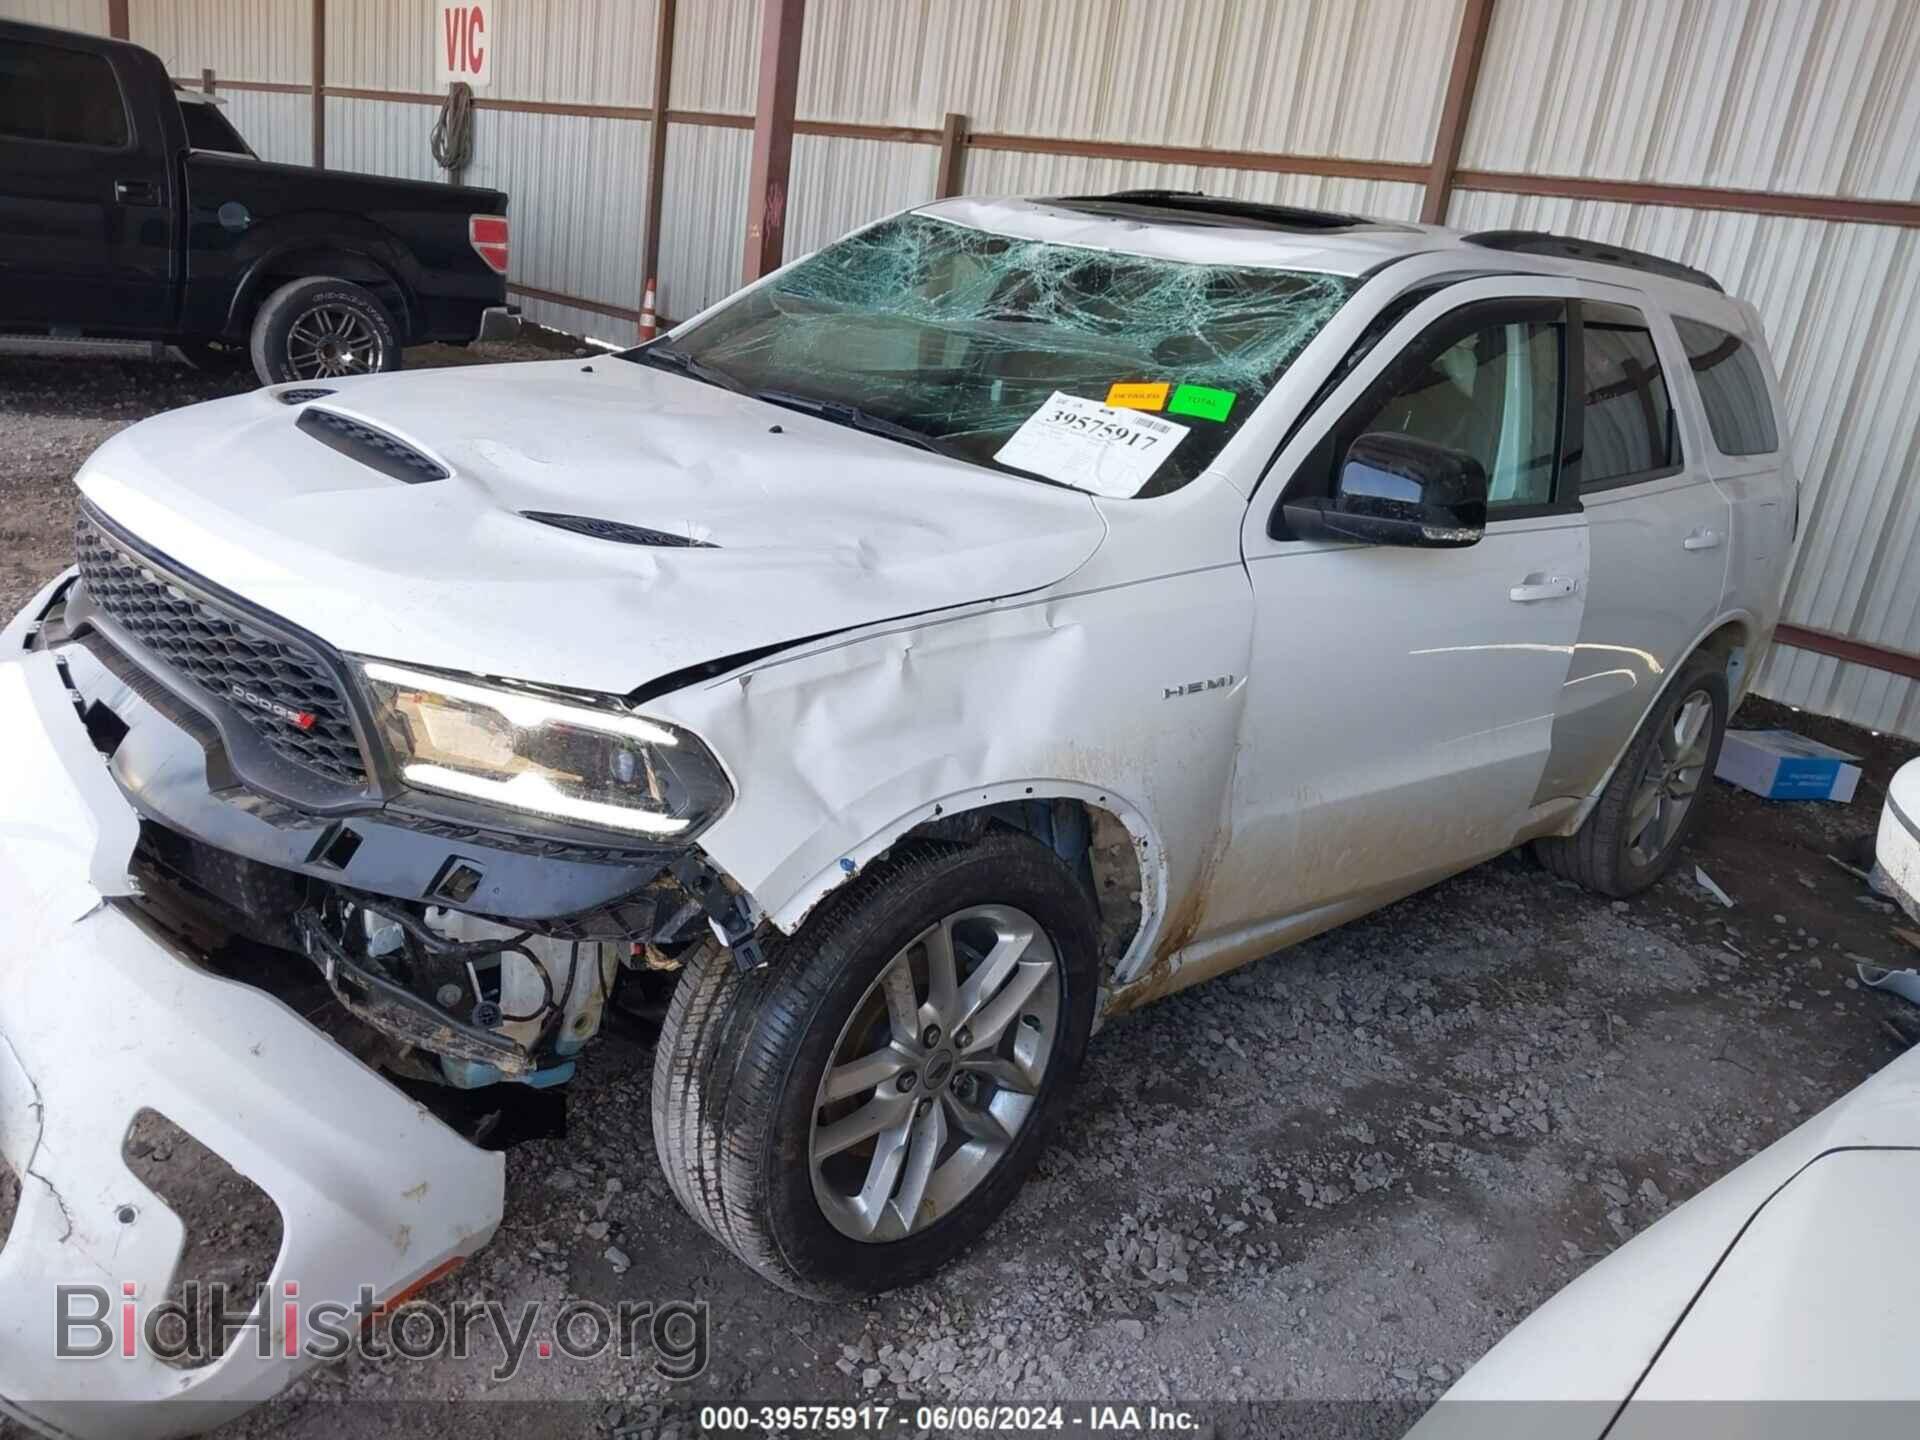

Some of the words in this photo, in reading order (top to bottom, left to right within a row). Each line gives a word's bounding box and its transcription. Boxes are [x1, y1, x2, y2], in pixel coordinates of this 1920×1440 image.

[445, 6, 484, 74] VIC
[1045, 410, 1159, 451] 39575917
[1164, 674, 1234, 699] HEMI
